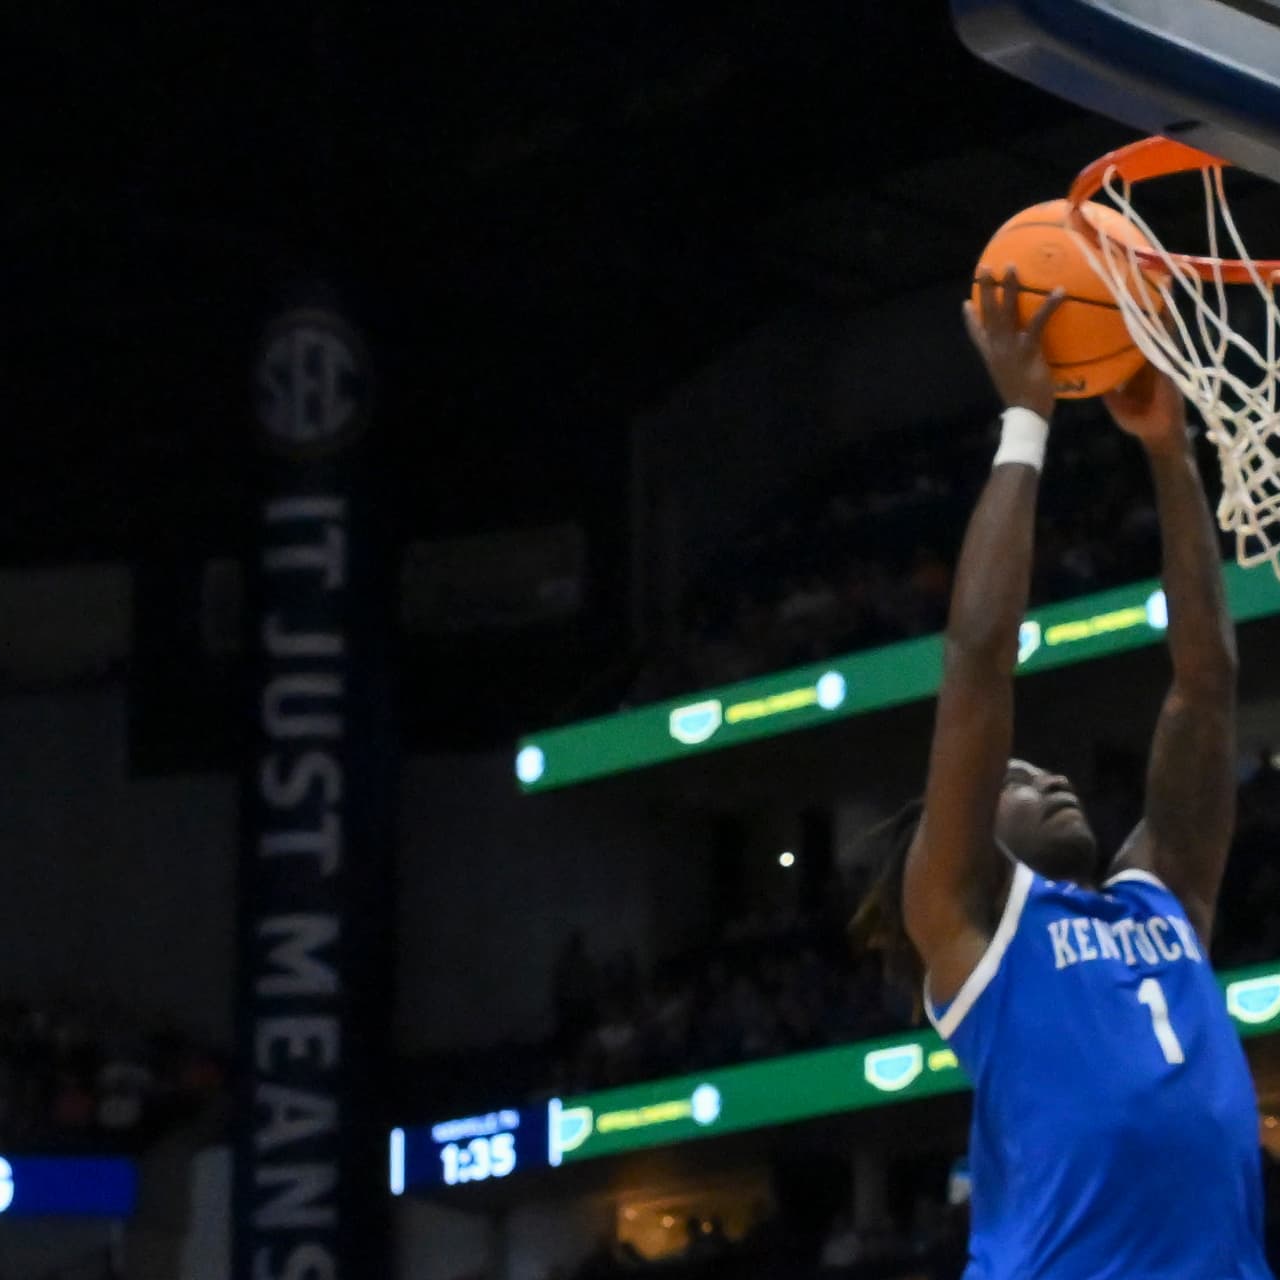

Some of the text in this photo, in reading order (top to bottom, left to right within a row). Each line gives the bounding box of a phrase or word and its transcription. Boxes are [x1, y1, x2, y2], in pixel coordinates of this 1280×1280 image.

[261, 498, 346, 591] IT
[259, 614, 345, 876] JUST
[1138, 977, 1185, 1064] 1
